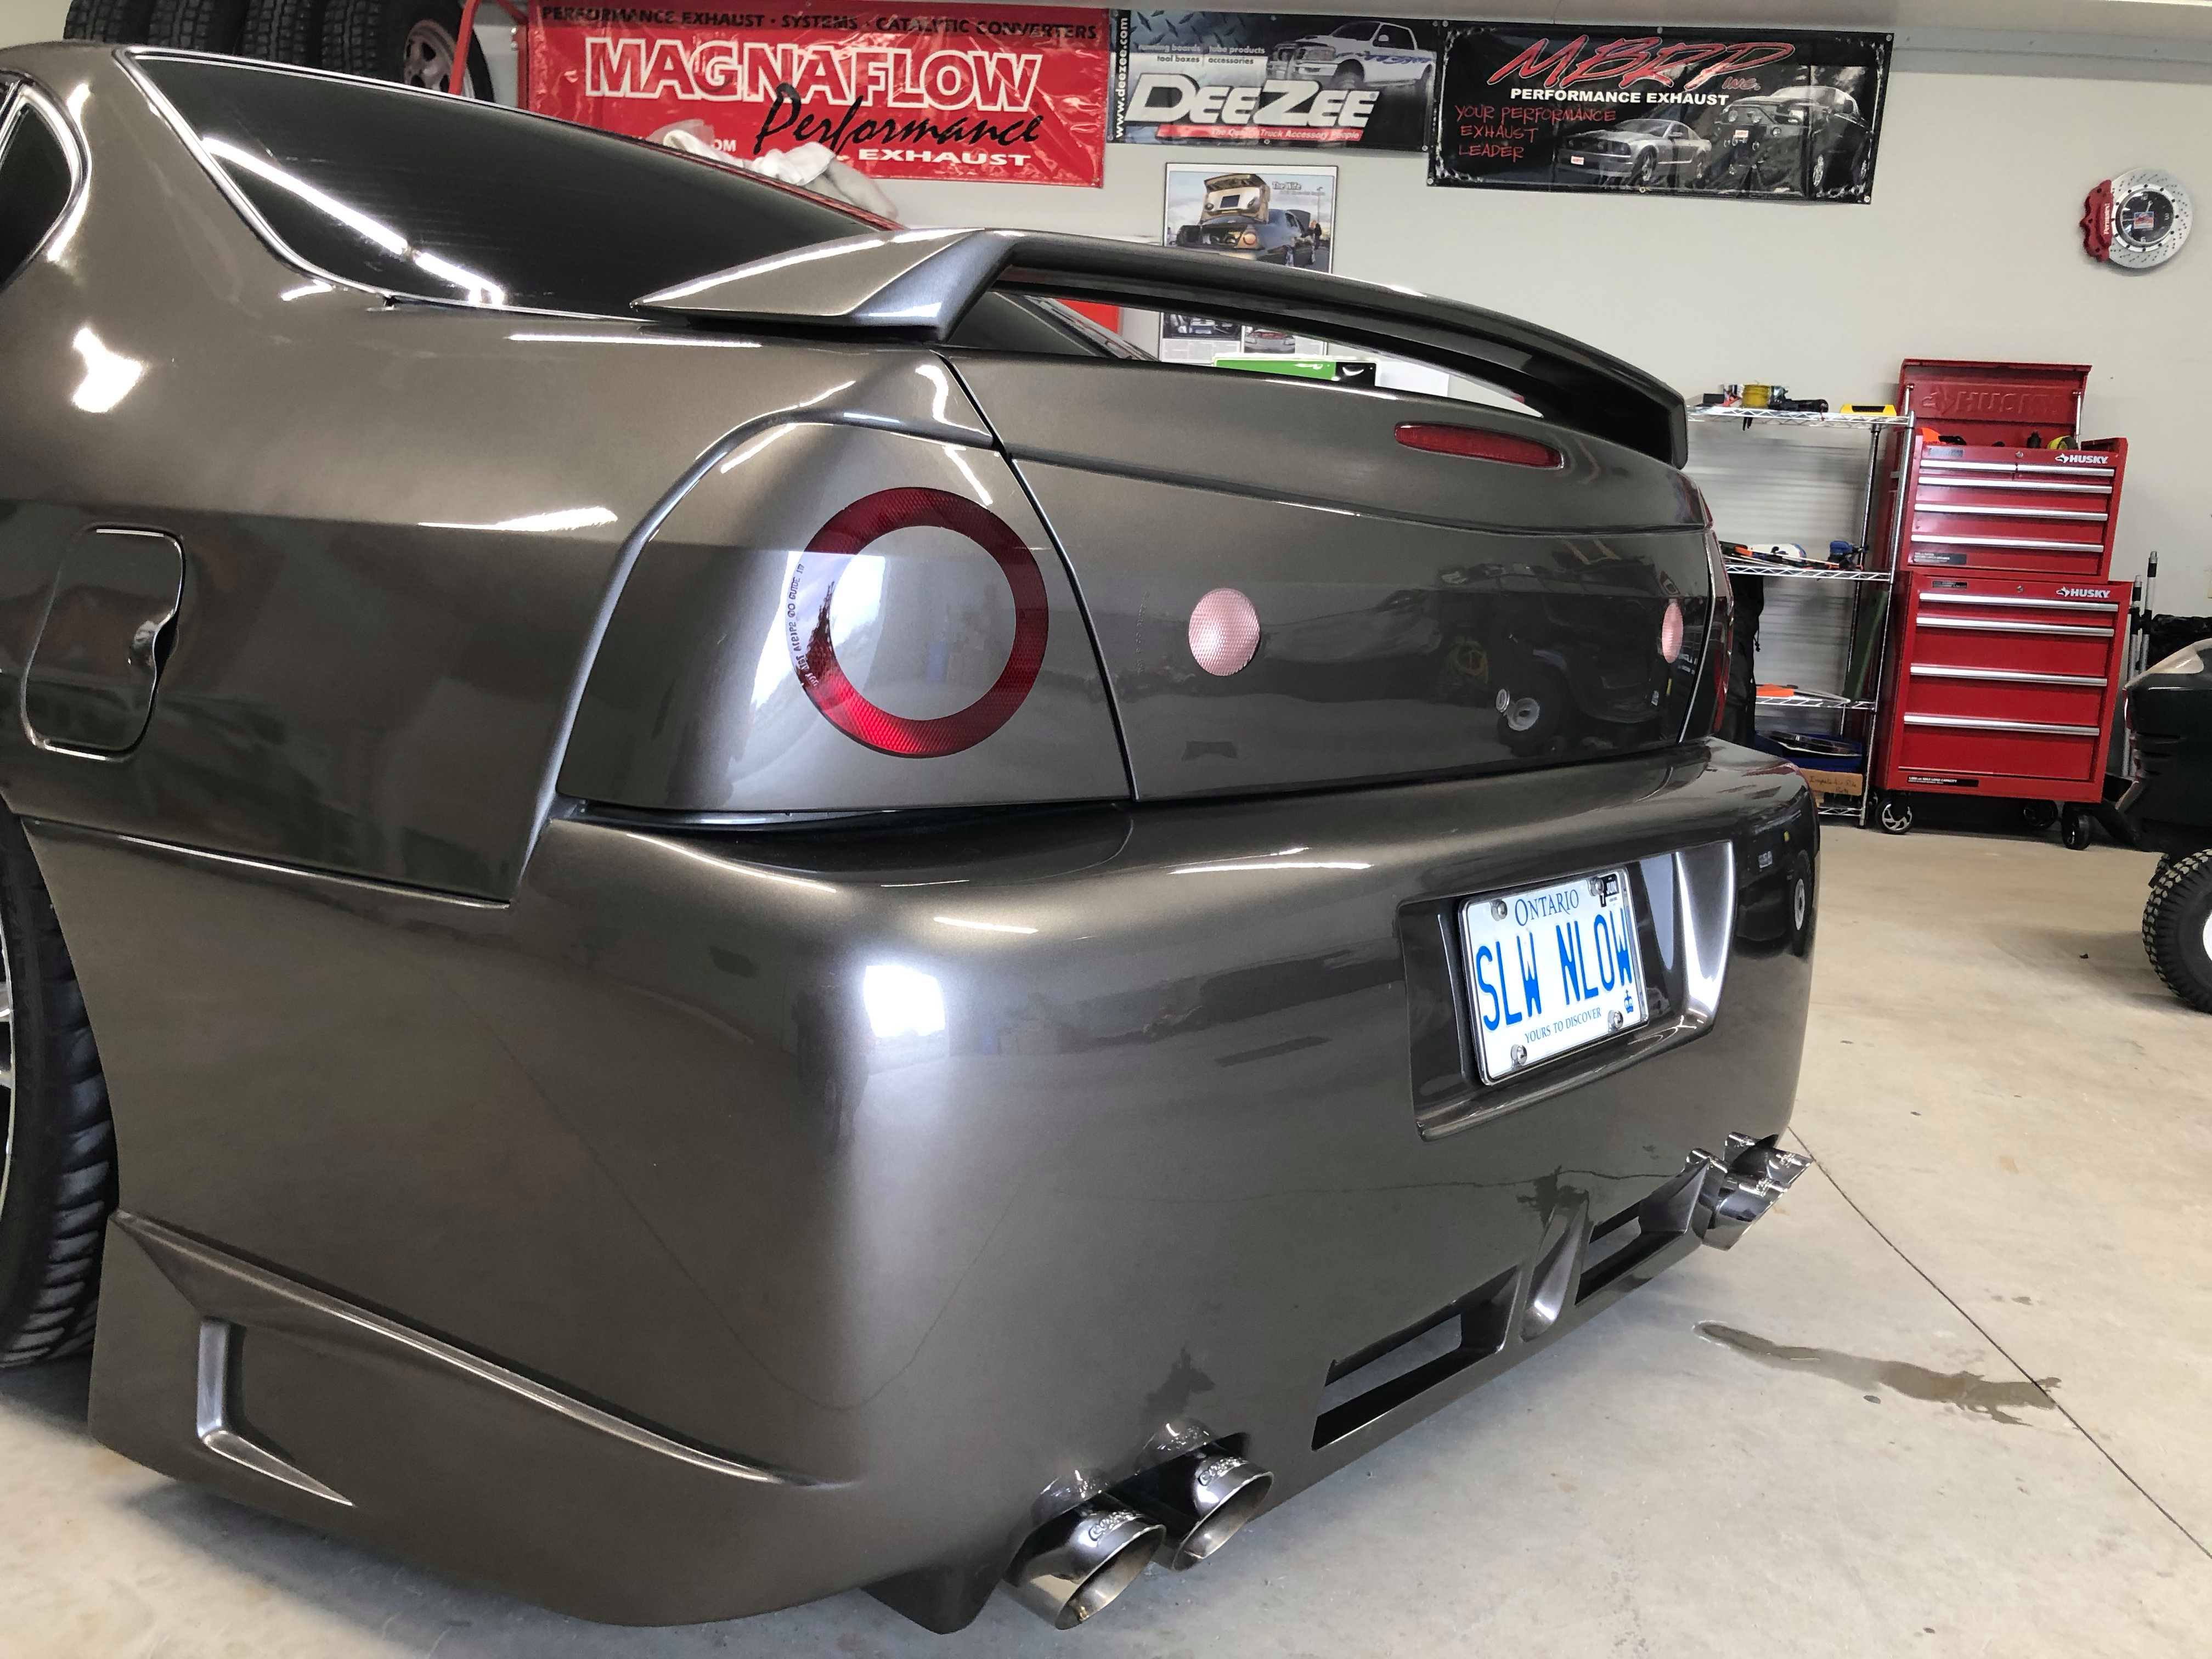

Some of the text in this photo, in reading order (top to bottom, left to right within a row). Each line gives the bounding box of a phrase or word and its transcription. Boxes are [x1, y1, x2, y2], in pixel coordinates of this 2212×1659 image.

[541, 6, 1097, 38] PERFORMANCE EXHAUST SYSTEMS CATALYTIC CONVERTERS
[1229, 46, 1266, 54] products
[1487, 35, 1795, 91] MBRP
[585, 37, 1043, 112] MAGNAFLOW
[1510, 88, 1729, 106] PERFORMANCE EXHAUST
[753, 83, 1043, 156] Performance
[1455, 104, 1616, 126] YOUR PERFORMANCE
[1285, 130, 1327, 140] Accessory
[1460, 124, 1539, 143] EXHAUST
[858, 149, 1031, 166] EXHAUST
[1459, 143, 1525, 162] LEADER
[2069, 455, 2109, 464] HUSKY
[2070, 588, 2111, 598] HUSKY
[1606, 881, 1617, 895] JUN
[1475, 907, 1633, 1031] SLW NLOW
[1524, 1008, 1601, 1043] YOURS TO DISCOVER
